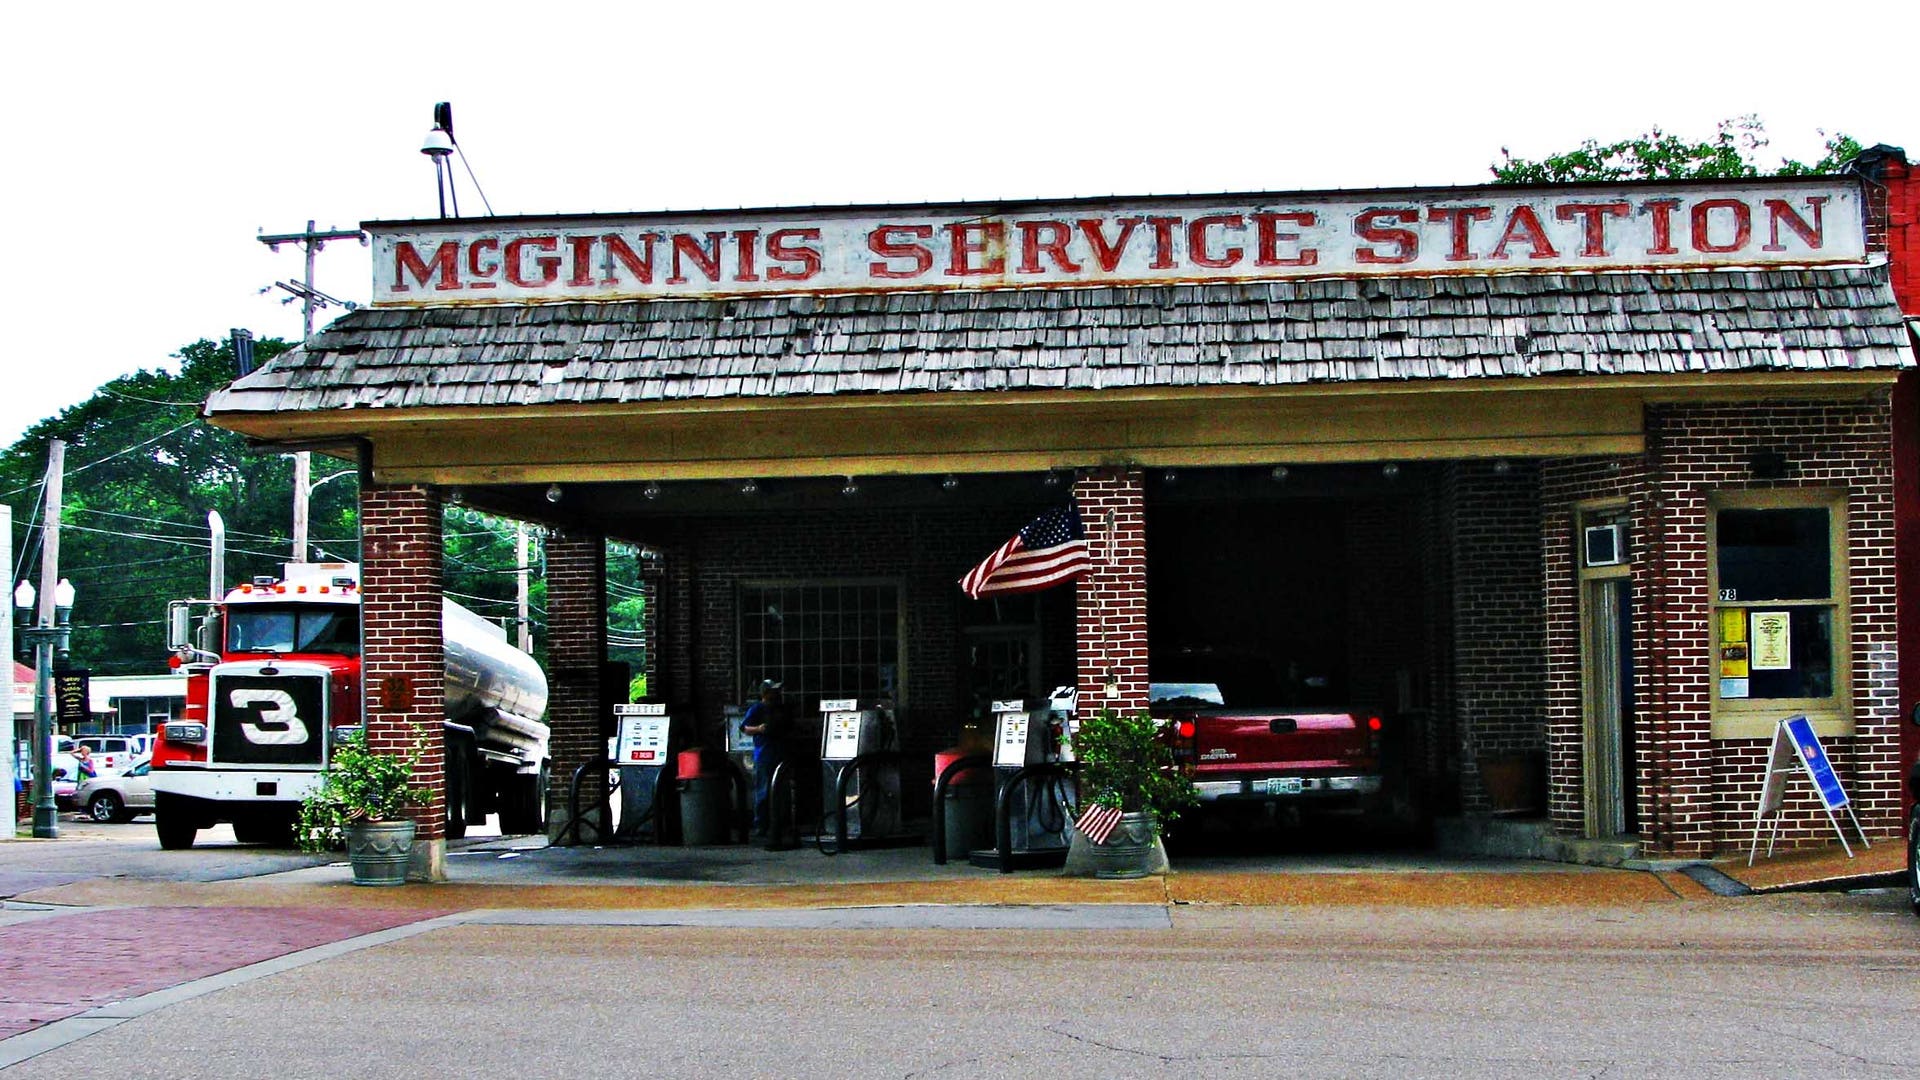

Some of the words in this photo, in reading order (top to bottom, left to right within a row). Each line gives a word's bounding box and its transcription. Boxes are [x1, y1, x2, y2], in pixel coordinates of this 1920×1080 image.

[867, 211, 1318, 279] SERVICE
[1352, 196, 1832, 264] STATION
[1720, 589, 1735, 601] 98
[230, 689, 309, 745] 3
